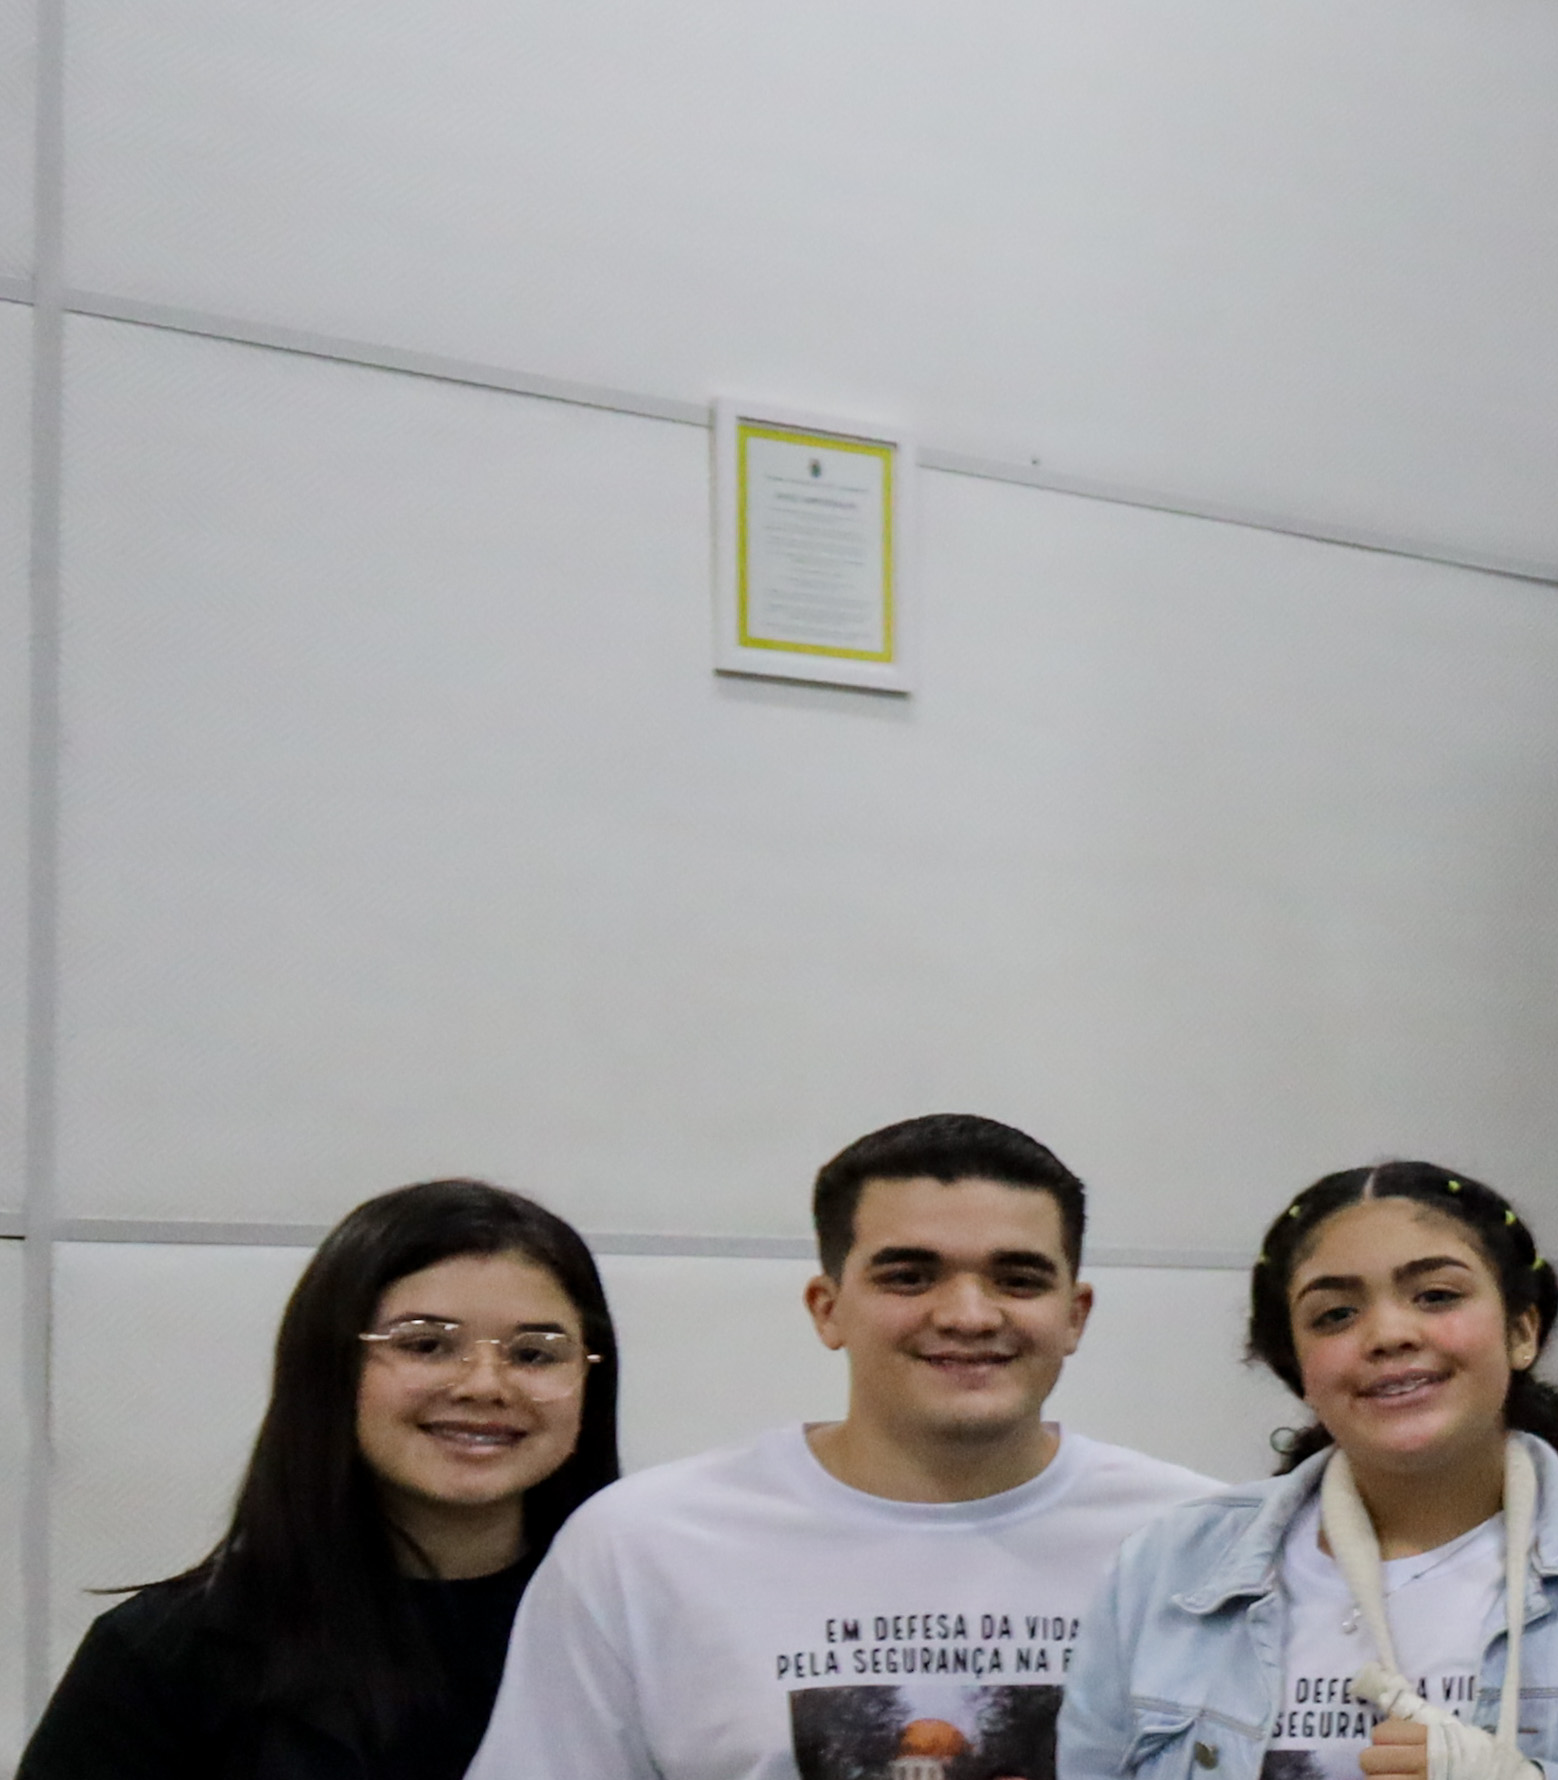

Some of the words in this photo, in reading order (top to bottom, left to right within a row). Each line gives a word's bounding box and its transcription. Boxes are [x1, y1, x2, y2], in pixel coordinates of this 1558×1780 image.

[826, 1618, 861, 1645] EM
[875, 1614, 967, 1641] DEFESA
[981, 1614, 1012, 1640] DA
[777, 1650, 839, 1680] PELA
[853, 1647, 1004, 1679] SEGURANÇA
[1016, 1648, 1049, 1673] NA
